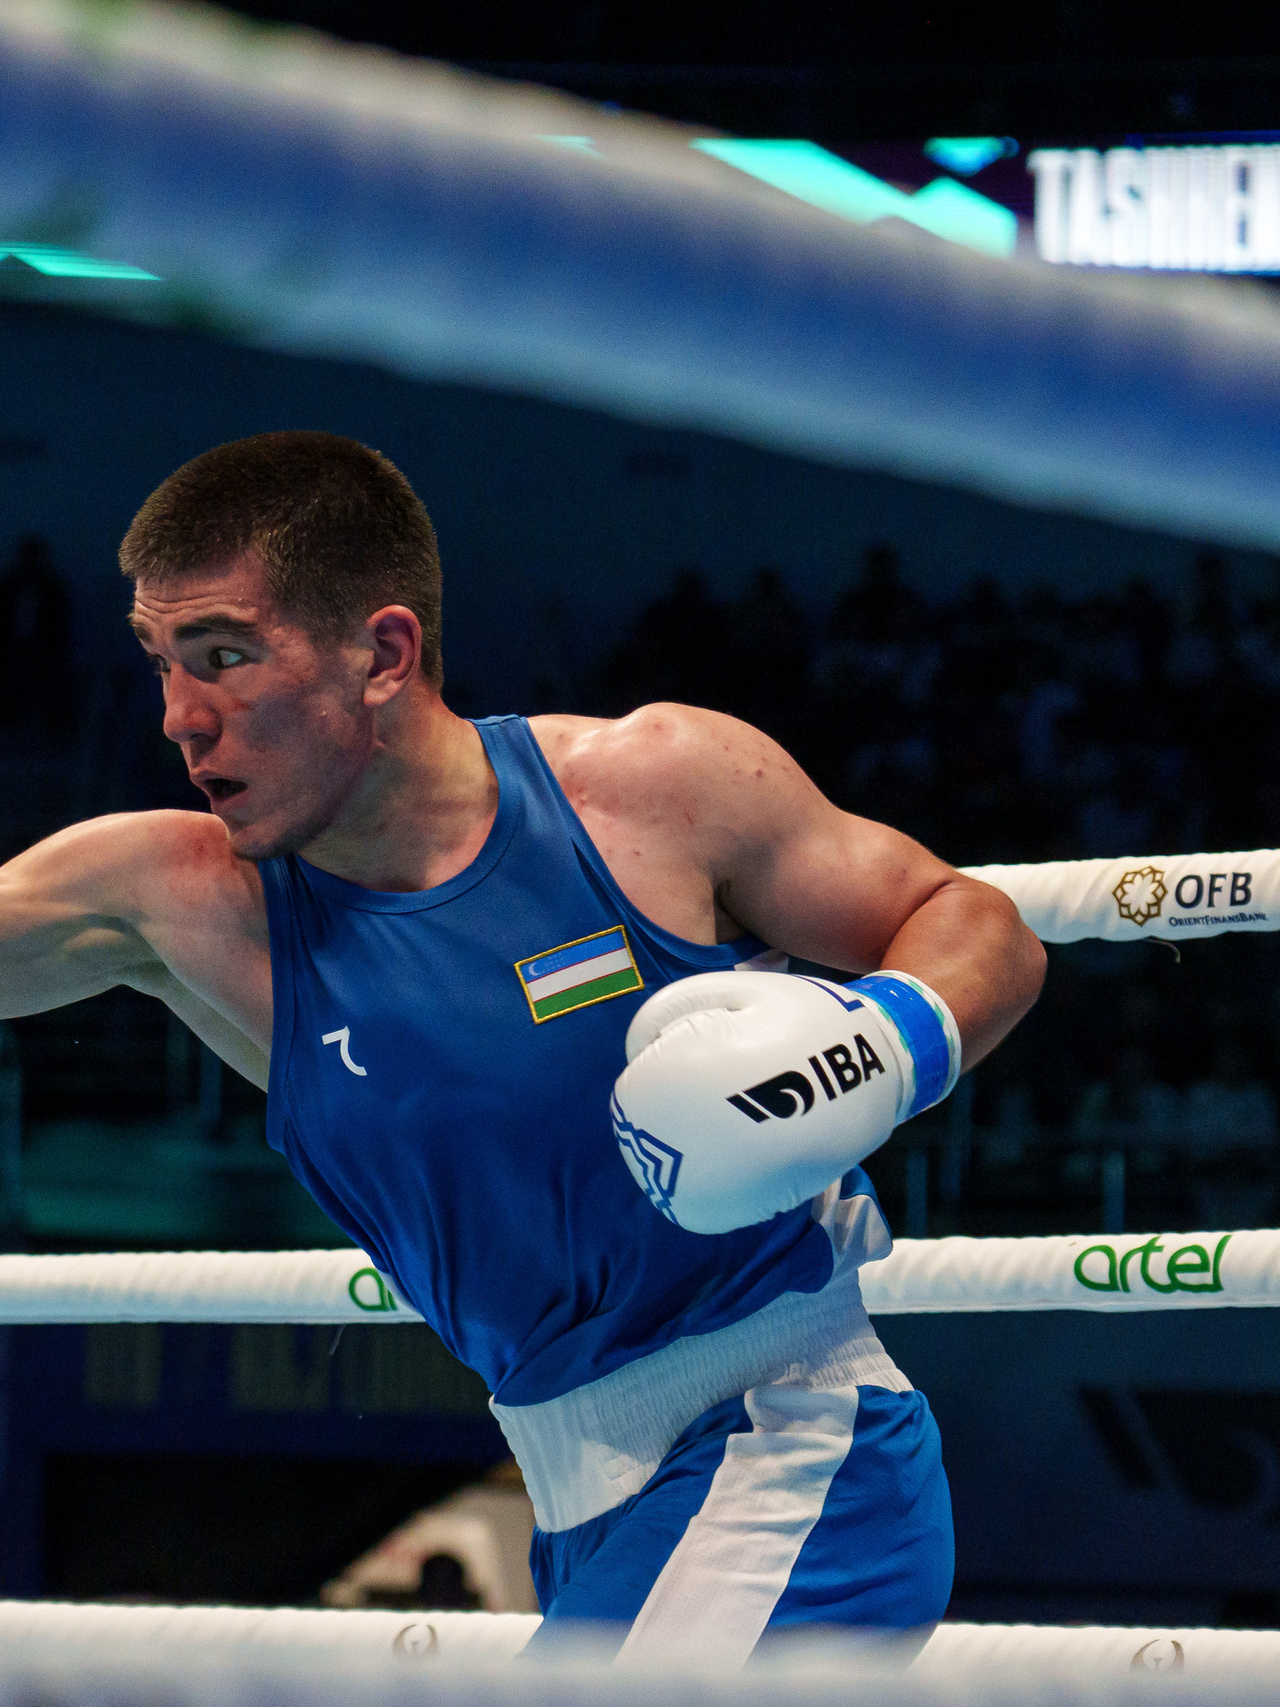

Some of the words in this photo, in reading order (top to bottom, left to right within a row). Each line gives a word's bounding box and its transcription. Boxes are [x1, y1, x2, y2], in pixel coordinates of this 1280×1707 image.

[1175, 872, 1253, 909] OFB
[807, 1033, 886, 1102] IBA
[1073, 1234, 1233, 1293] artel
